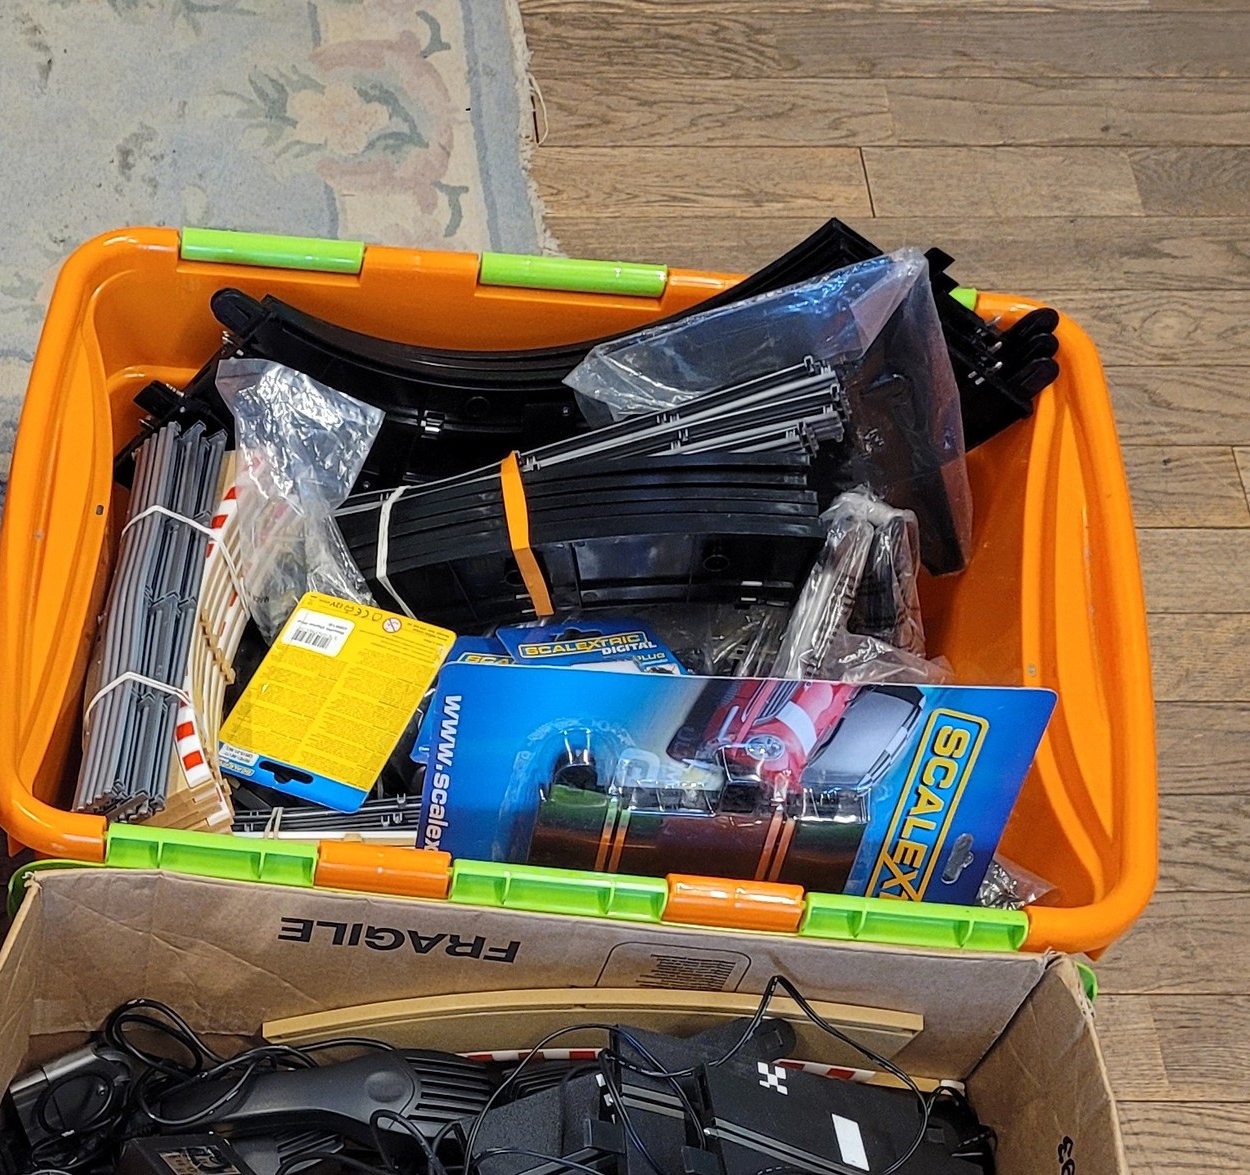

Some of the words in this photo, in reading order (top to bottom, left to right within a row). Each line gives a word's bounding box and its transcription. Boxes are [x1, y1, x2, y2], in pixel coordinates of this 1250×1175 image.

[523, 633, 641, 656] SCALEXTRIC
[601, 639, 658, 656] DIGITAL
[277, 917, 521, 964] FRAGILE
